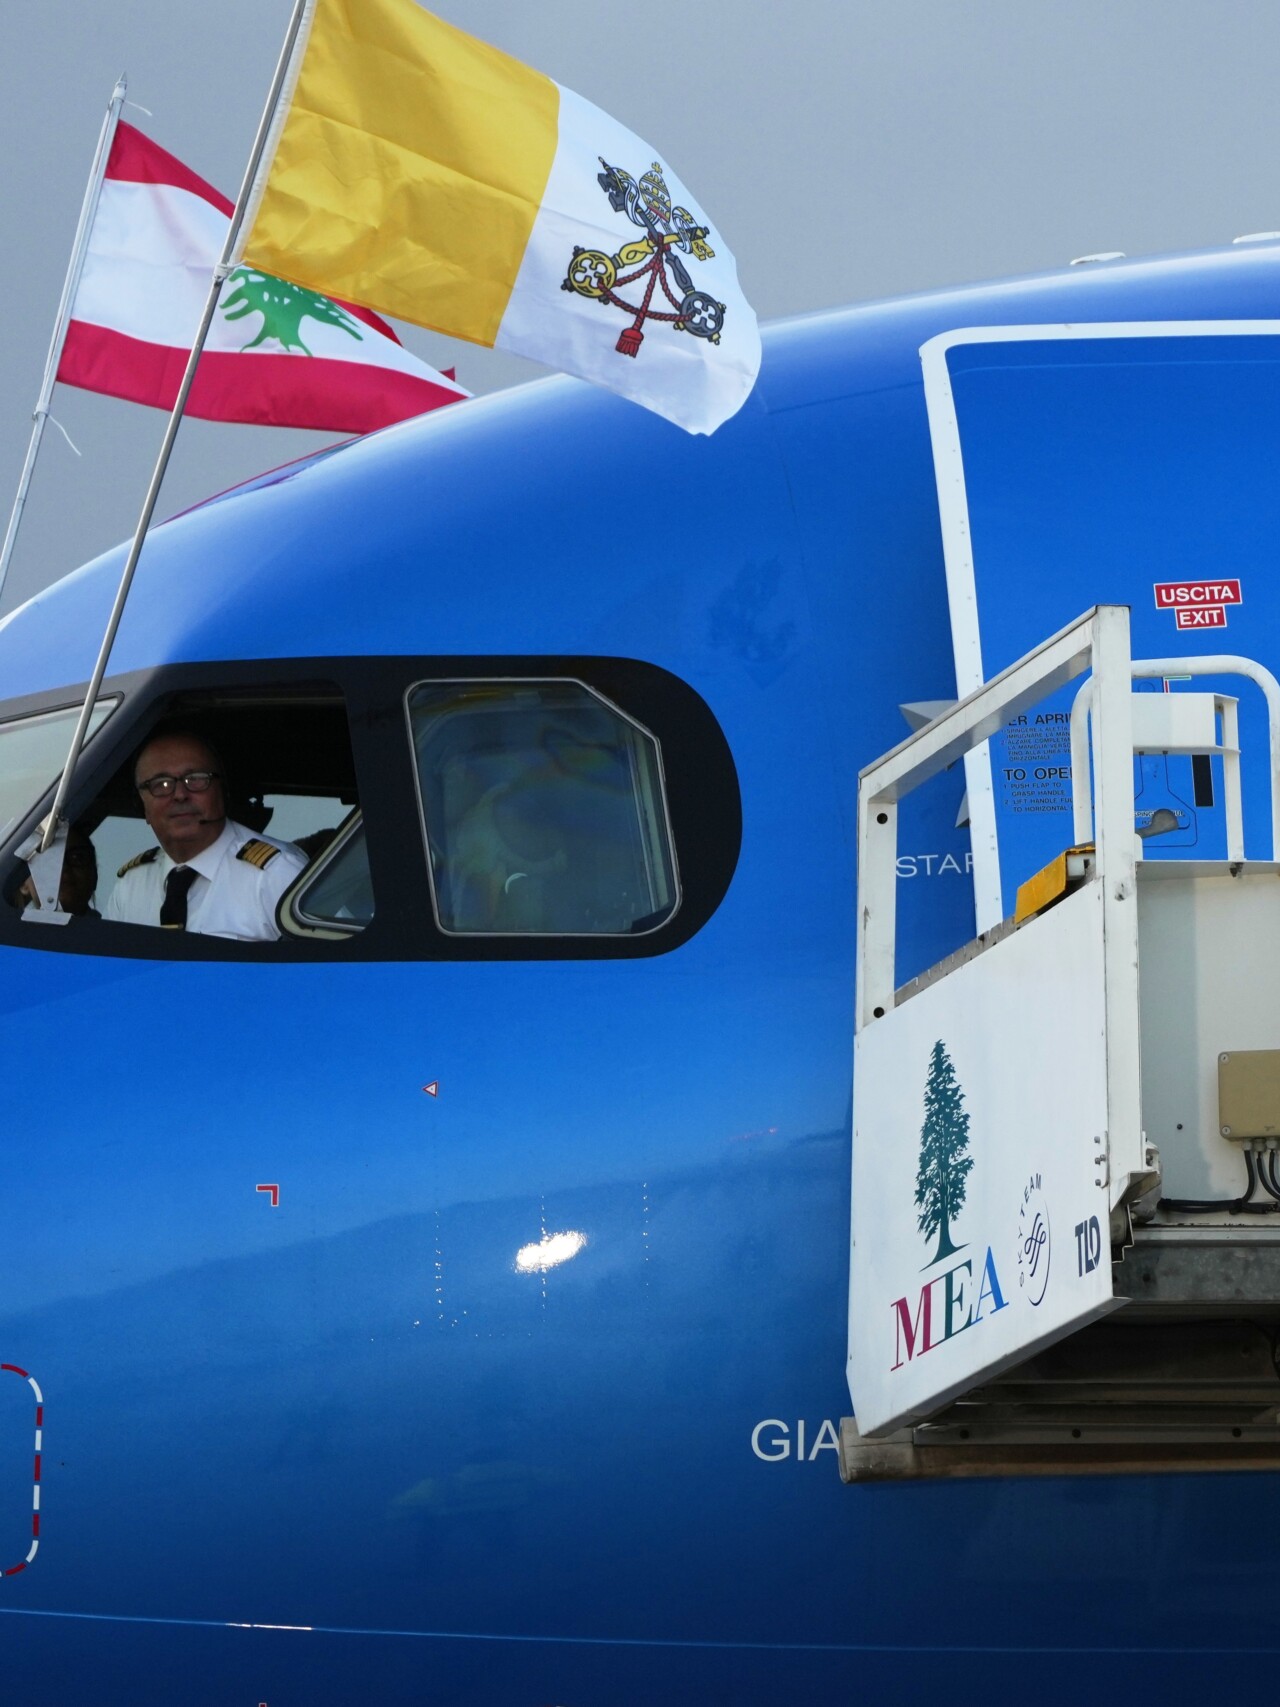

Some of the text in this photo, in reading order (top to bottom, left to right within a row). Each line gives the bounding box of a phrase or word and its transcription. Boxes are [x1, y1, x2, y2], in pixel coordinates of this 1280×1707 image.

[1161, 585, 1234, 603] USCITA
[1179, 609, 1220, 626] EXIT
[1003, 767, 1072, 781] TO OPE
[1075, 1215, 1101, 1278] TLD
[890, 1246, 1009, 1372] MEA
[751, 1418, 840, 1461] GIA
